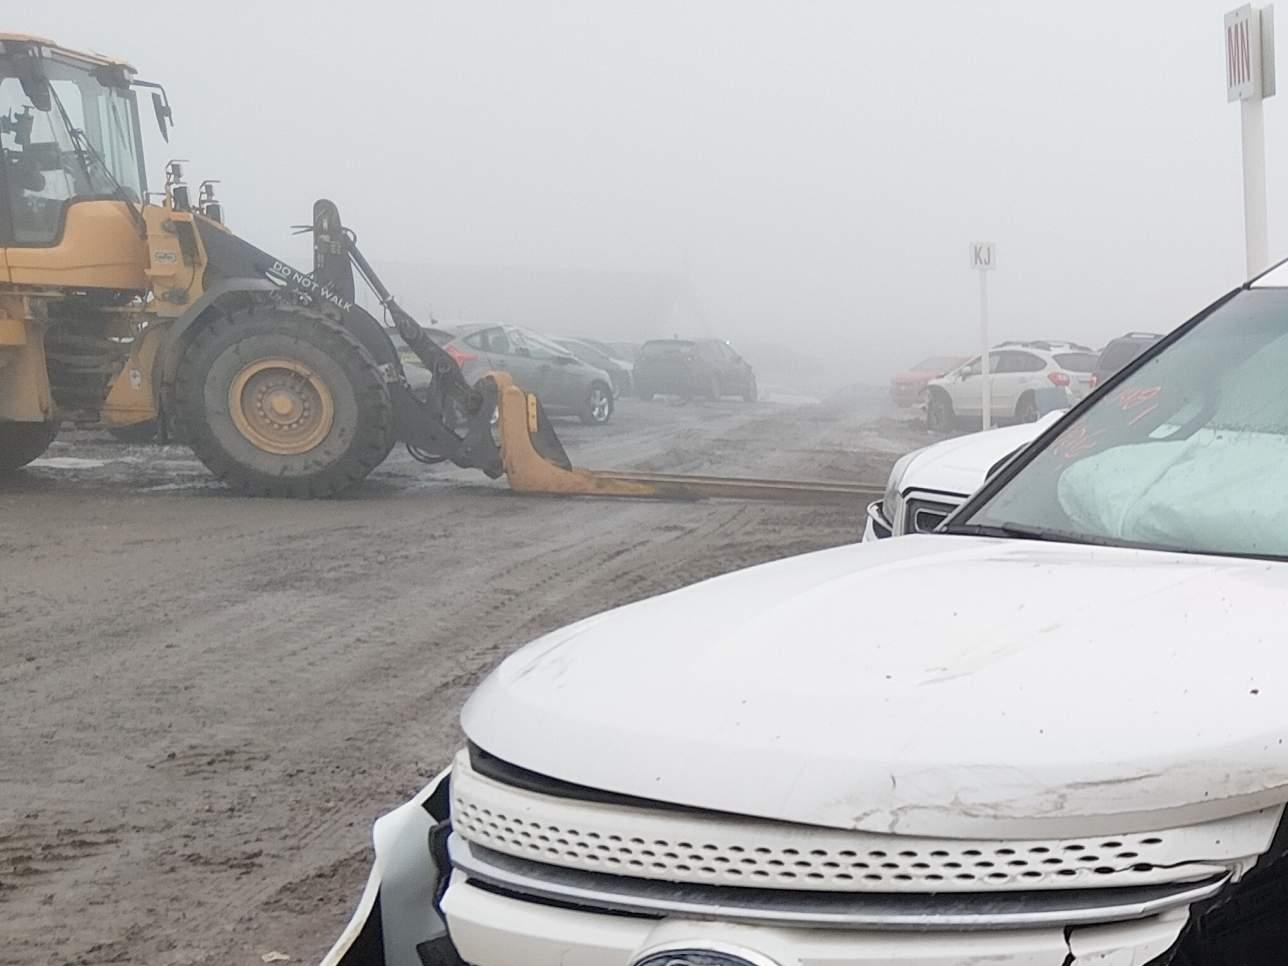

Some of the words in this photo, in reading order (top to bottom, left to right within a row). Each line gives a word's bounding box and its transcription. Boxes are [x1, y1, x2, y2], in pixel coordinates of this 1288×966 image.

[1227, 18, 1251, 88] MN
[974, 245, 991, 266] KJ
[273, 261, 292, 276] DO
[292, 272, 320, 291] NOT
[321, 287, 352, 313] WALK
